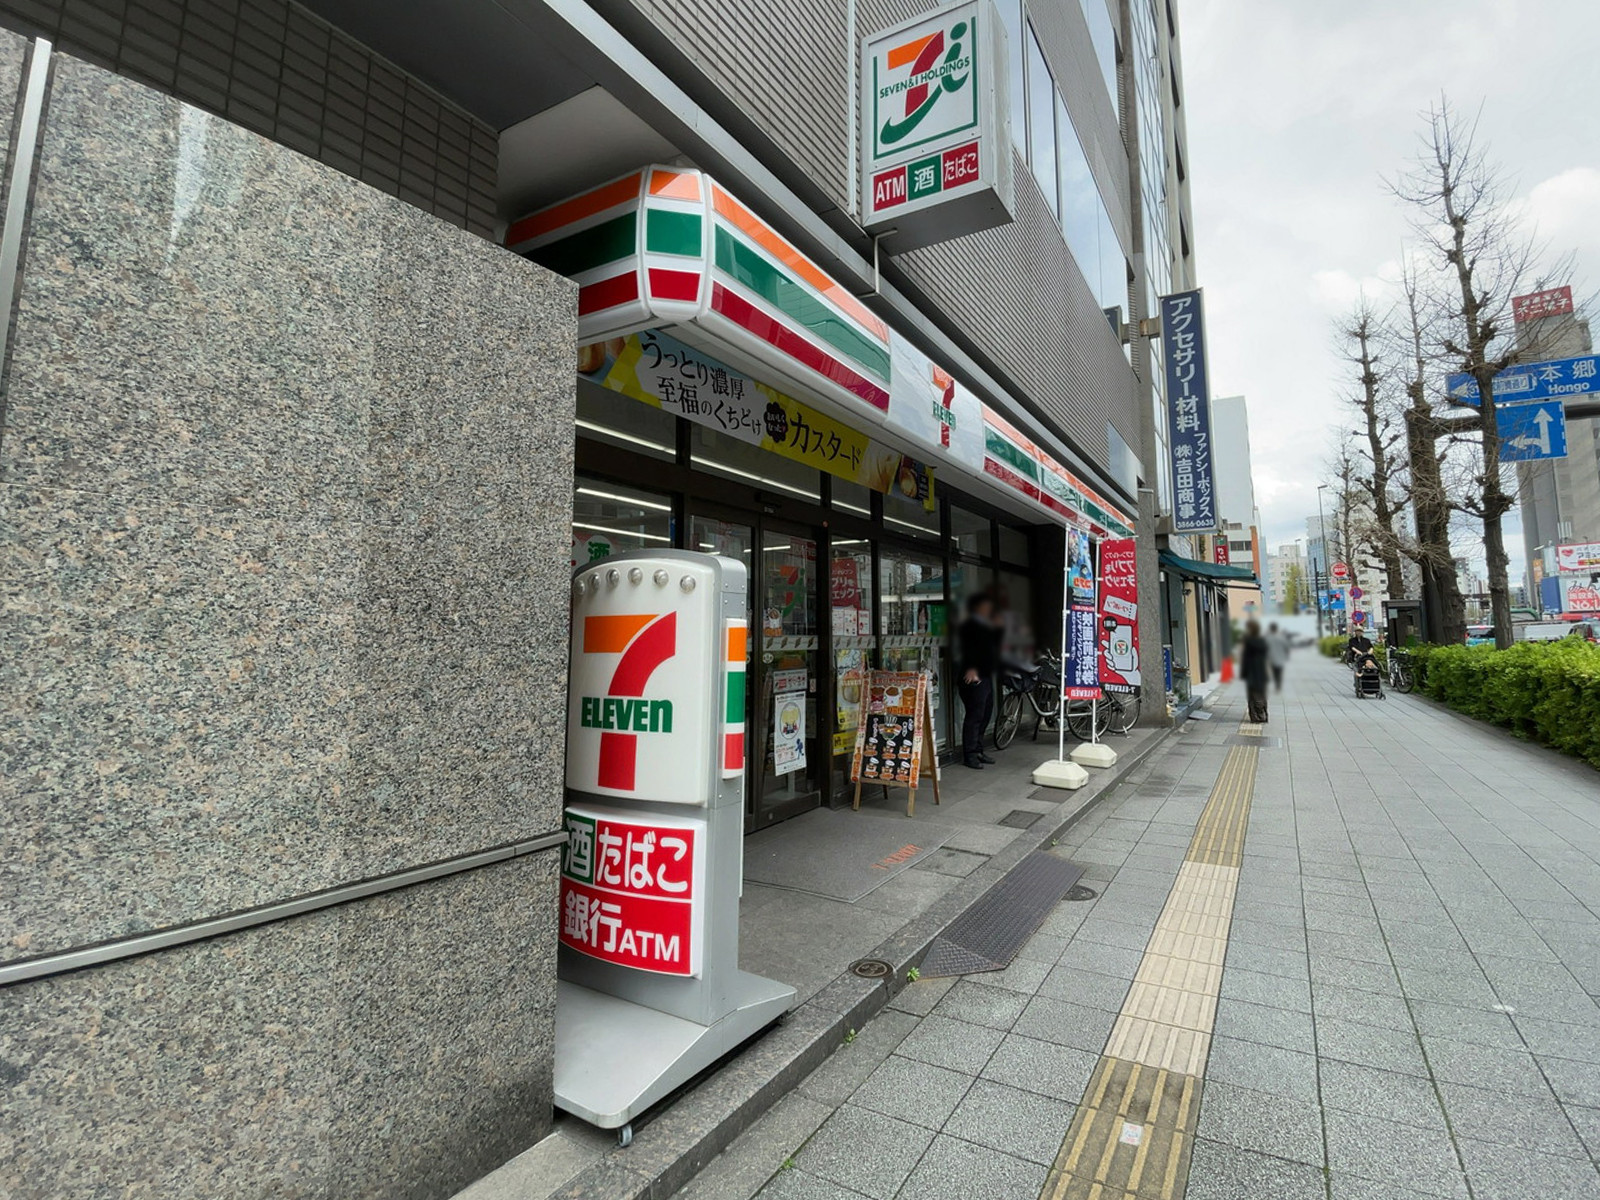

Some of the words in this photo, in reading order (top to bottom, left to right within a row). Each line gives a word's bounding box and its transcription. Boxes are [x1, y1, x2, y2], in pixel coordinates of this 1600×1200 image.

[920, 56, 970, 85] HOLDINGS
[875, 174, 905, 204] ATM
[914, 164, 935, 193] 酒
[944, 152, 978, 182] たばこ
[641, 330, 745, 401] うっとり濃厚
[1169, 296, 1200, 434] アクセサリー材料
[1539, 359, 1597, 383] 本郷
[1548, 381, 1590, 395] Hongo
[656, 376, 761, 436] 至福のくちどけ
[789, 411, 862, 471] カスタード
[1194, 432, 1212, 518] ファンシーボックス
[565, 816, 594, 879] 酒
[597, 825, 689, 893] たばこ
